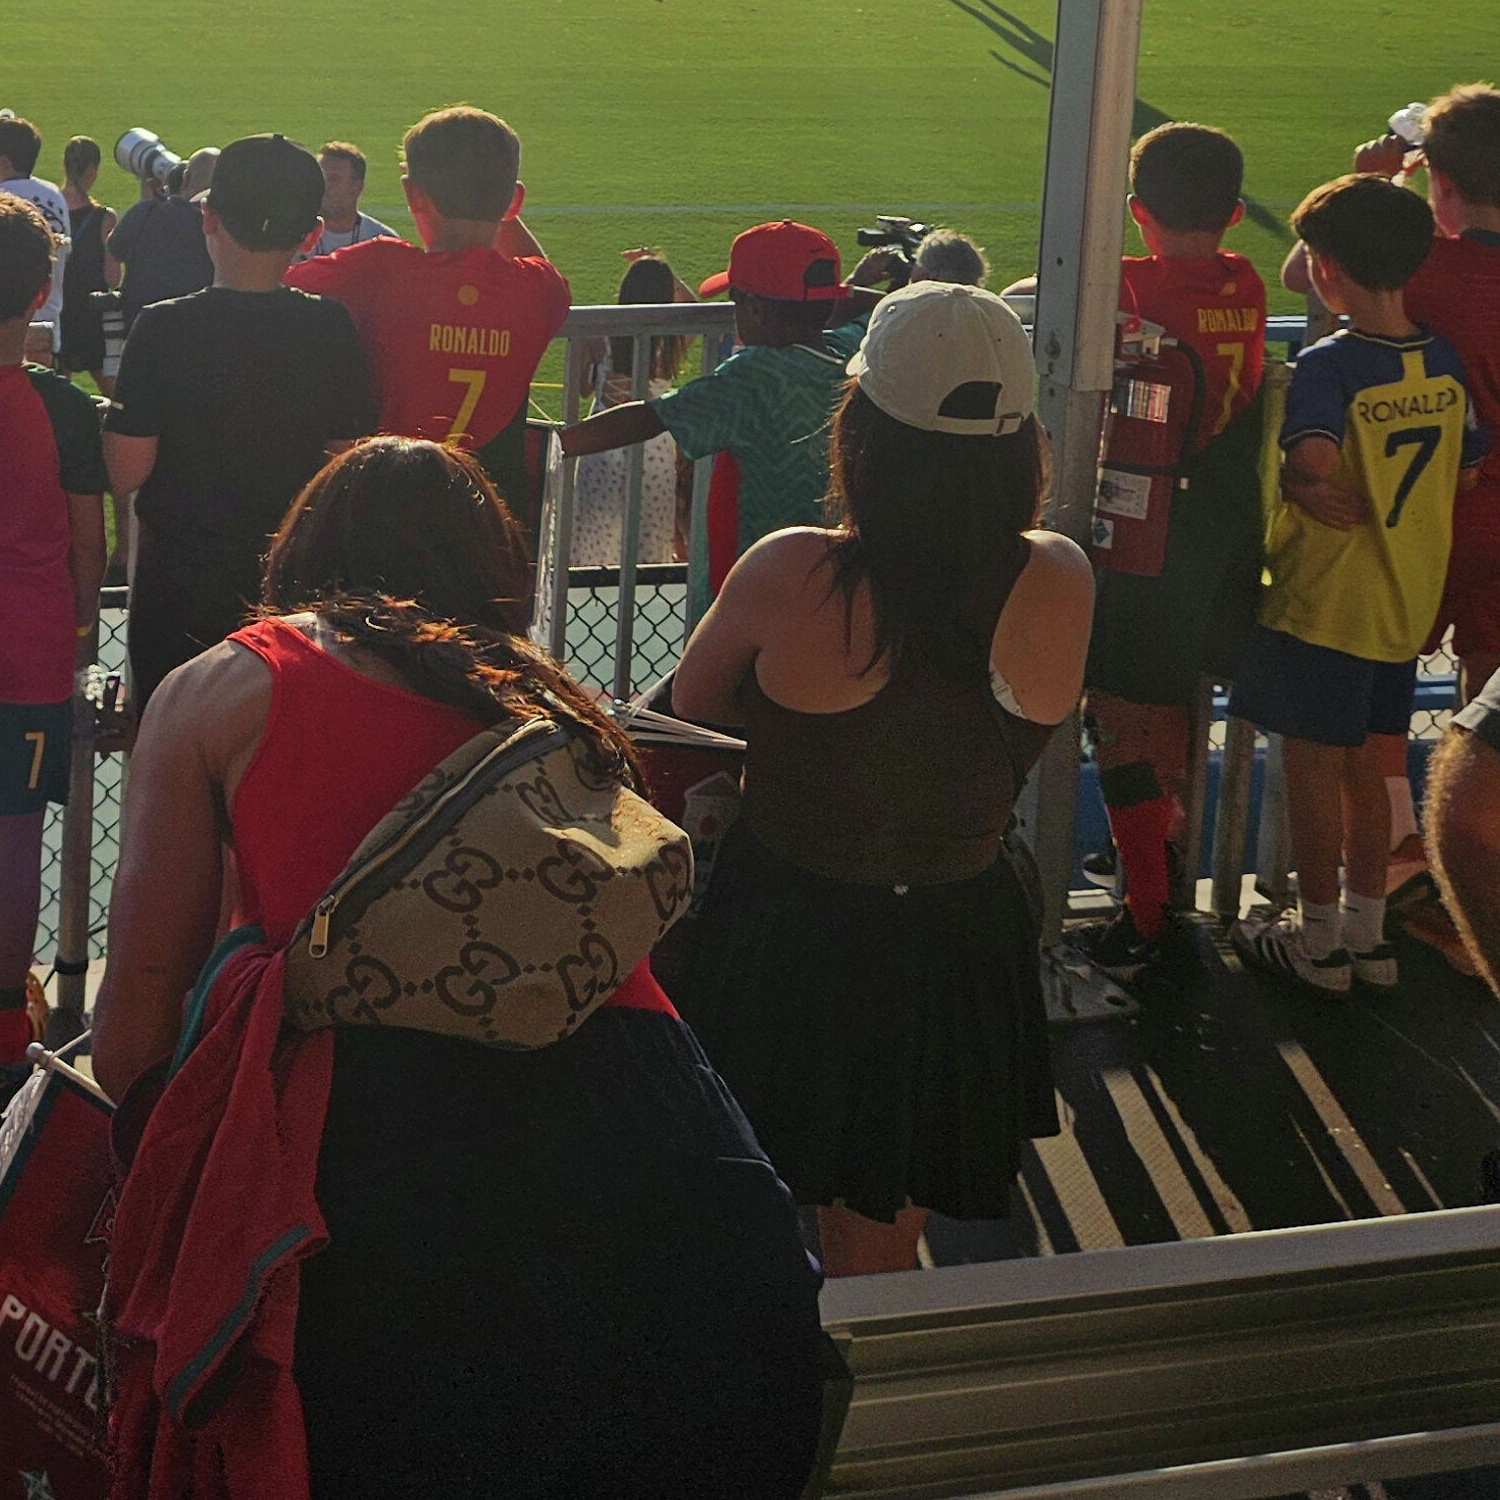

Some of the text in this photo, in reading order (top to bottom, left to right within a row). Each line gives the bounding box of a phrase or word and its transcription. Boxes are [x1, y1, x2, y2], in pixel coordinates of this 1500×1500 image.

[429, 323, 511, 357] RONALDO
[446, 368, 488, 448] 7
[1211, 342, 1245, 438] 7
[1385, 424, 1443, 530] 7
[25, 731, 46, 790] 7
